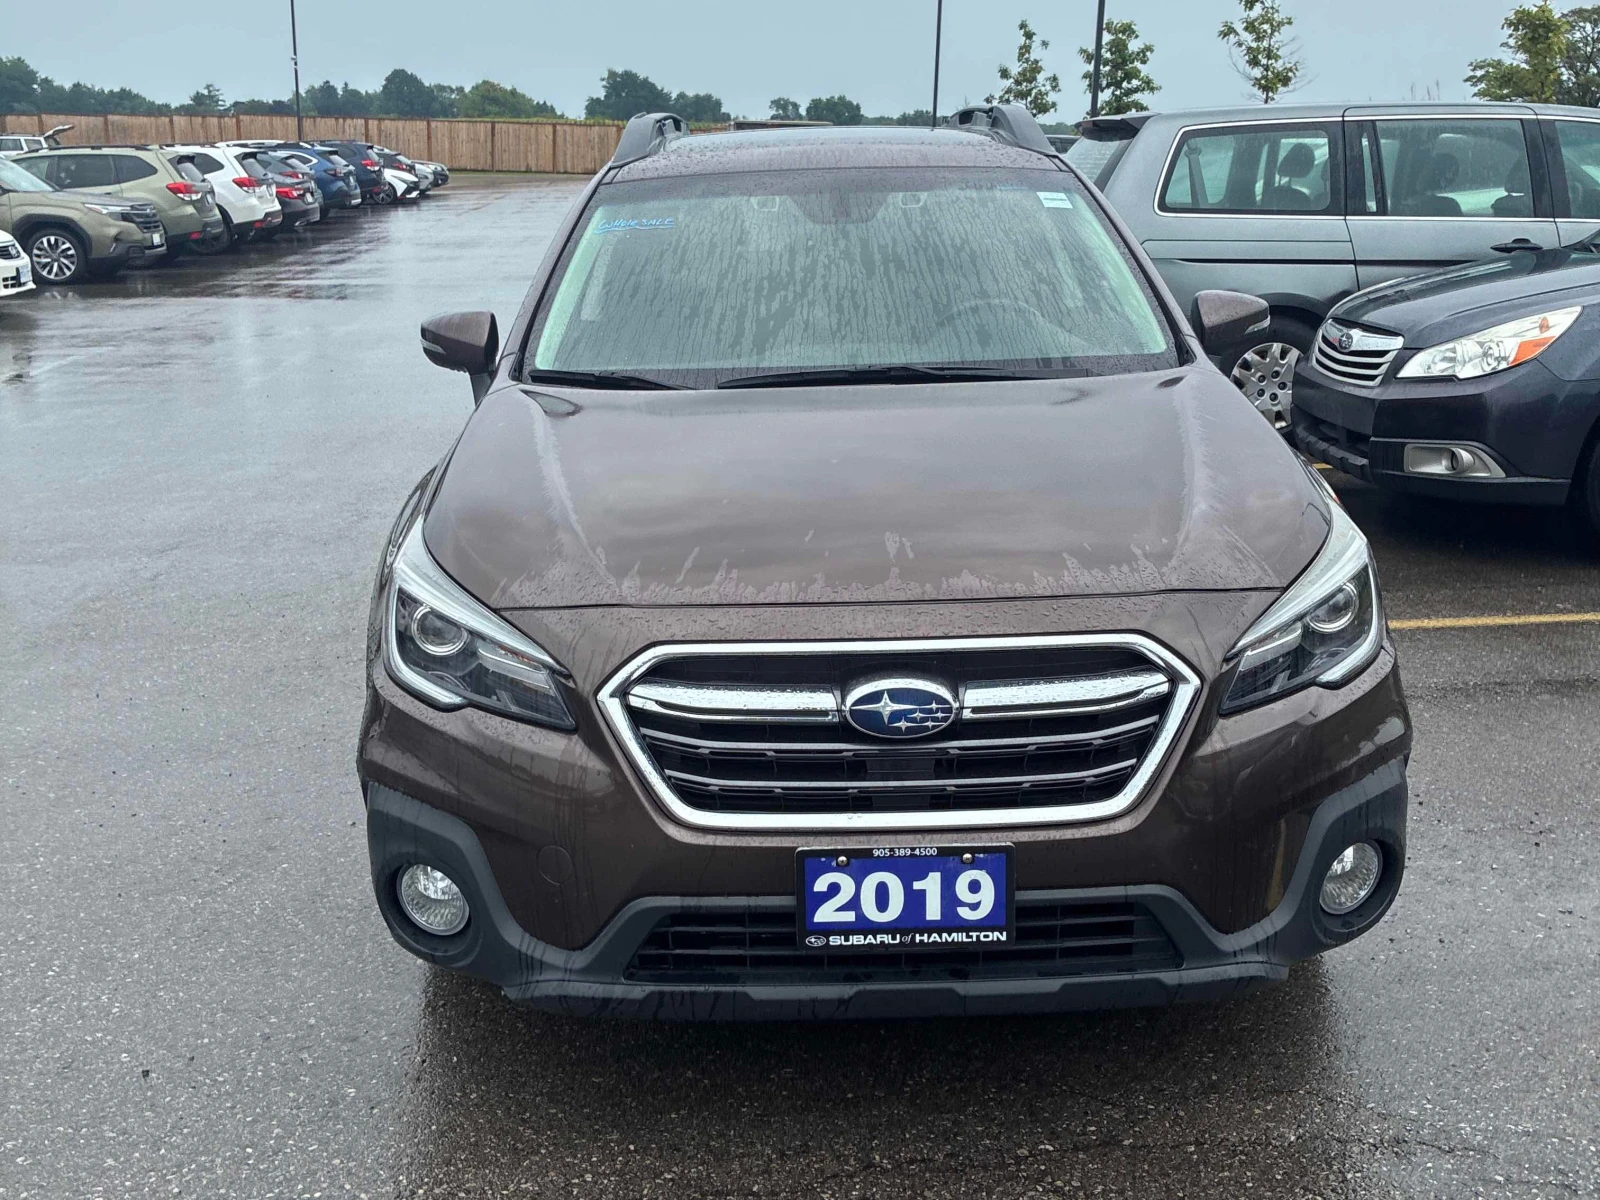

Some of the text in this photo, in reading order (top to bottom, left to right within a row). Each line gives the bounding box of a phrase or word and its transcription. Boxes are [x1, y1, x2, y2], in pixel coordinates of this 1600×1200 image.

[872, 847, 938, 858] 905-389-4500
[813, 869, 995, 923] 2019
[829, 931, 1007, 946] SUBARU of HAMILTON
